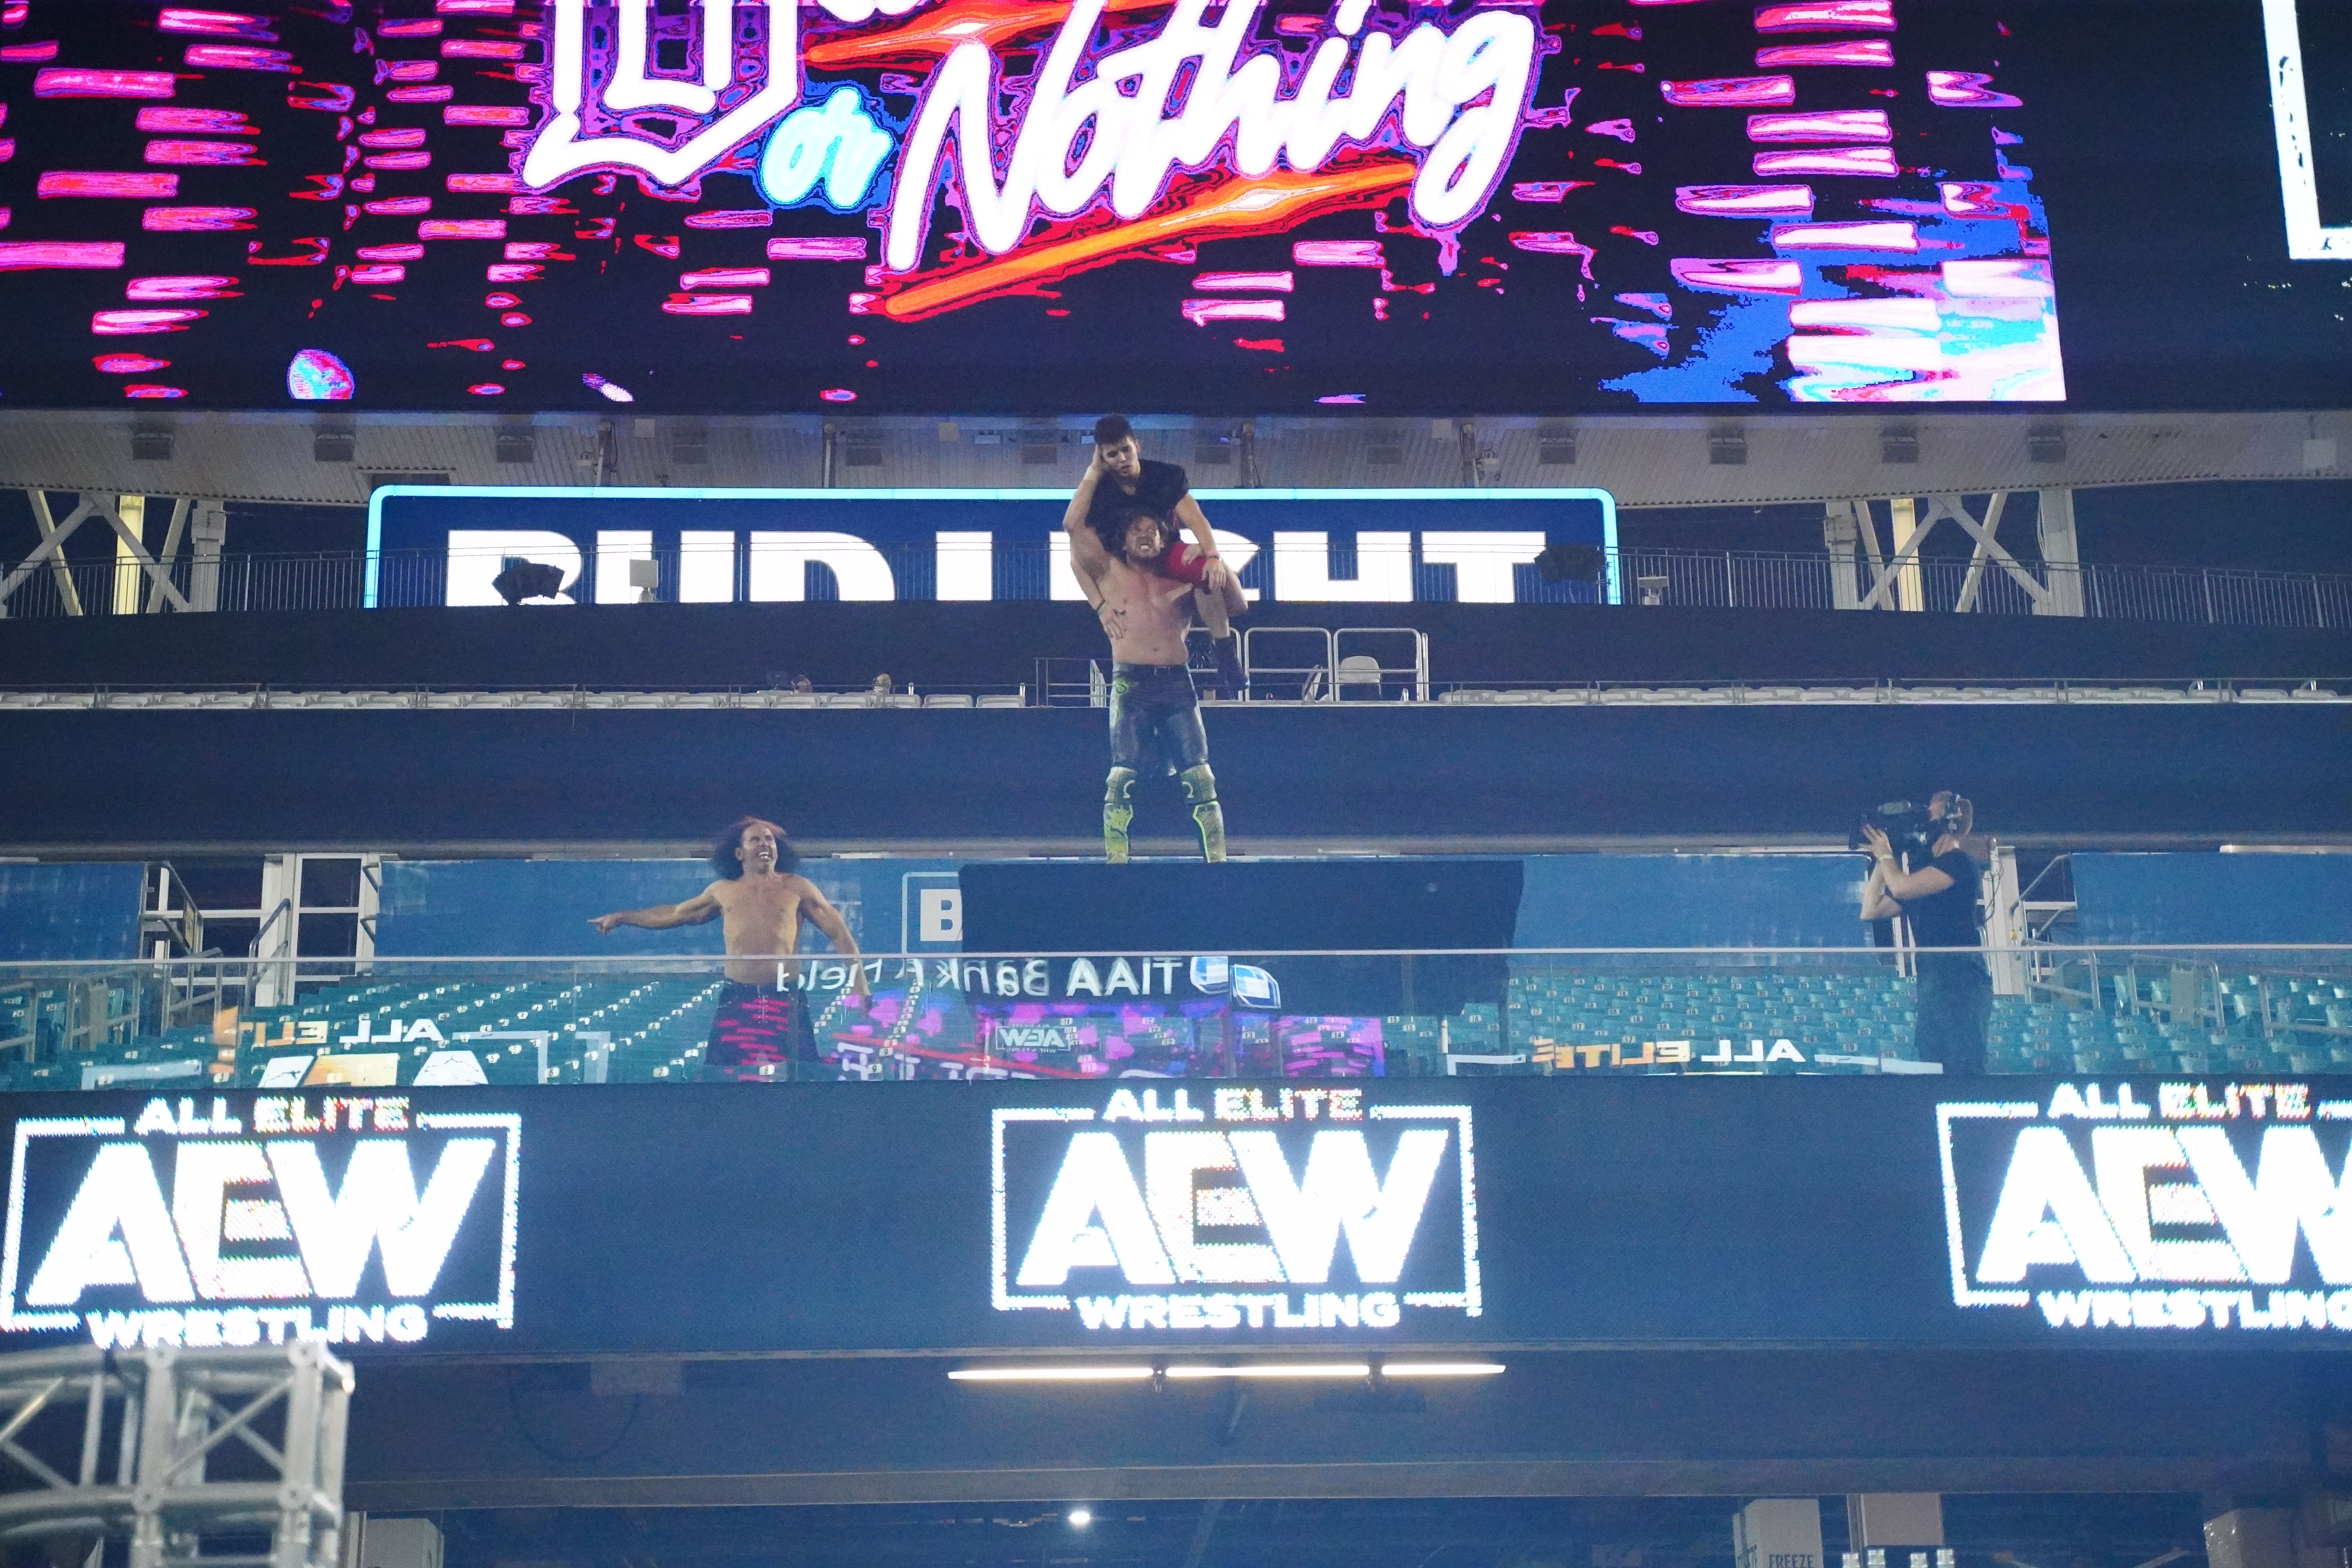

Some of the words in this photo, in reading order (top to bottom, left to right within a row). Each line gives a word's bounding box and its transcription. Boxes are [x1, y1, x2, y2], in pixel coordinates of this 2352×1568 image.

[762, 87, 895, 210] or
[887, 0, 1541, 271] Nothing
[133, 1096, 242, 1135] ALL
[253, 1096, 410, 1133] ELITE
[1102, 1089, 1204, 1122] ALL
[1214, 1088, 1363, 1121] ELITE
[2047, 1082, 2152, 1119] ALL
[2158, 1082, 2311, 1119] ELITE
[25, 1137, 497, 1307] AEW
[1016, 1129, 1448, 1285] AEW
[1975, 1125, 2352, 1285] AEW
[86, 1304, 428, 1350] WRESTLING
[1076, 1291, 1401, 1329] WRESTLING
